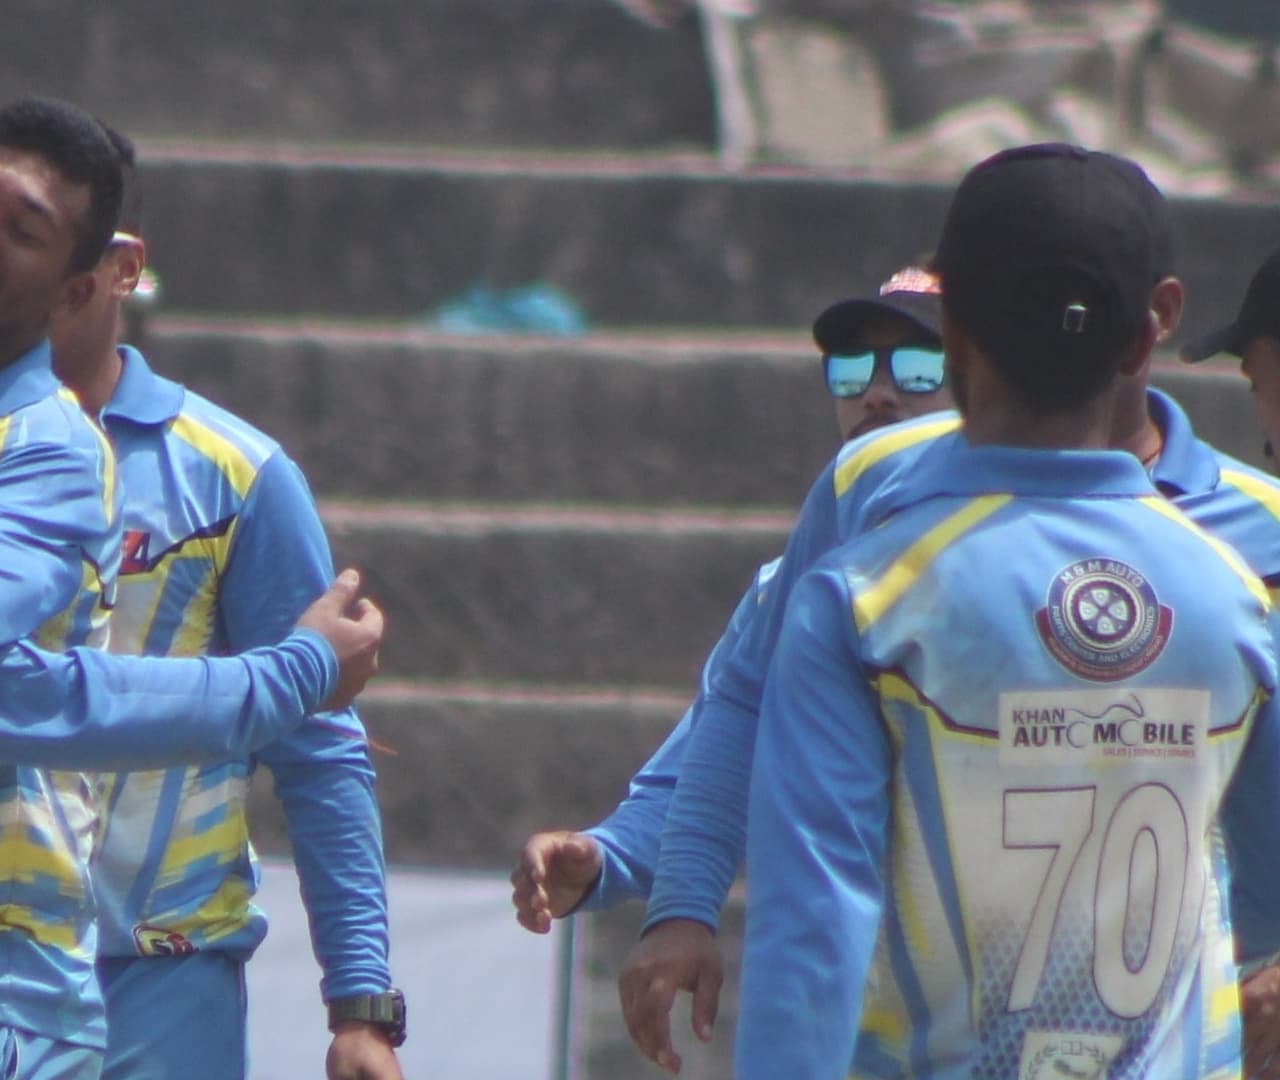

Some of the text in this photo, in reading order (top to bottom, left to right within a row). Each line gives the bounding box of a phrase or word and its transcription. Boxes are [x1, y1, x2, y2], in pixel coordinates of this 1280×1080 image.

[1105, 562, 1145, 588] AUTO
[1012, 708, 1066, 724] KHAN
[1002, 781, 1190, 1020] 70
